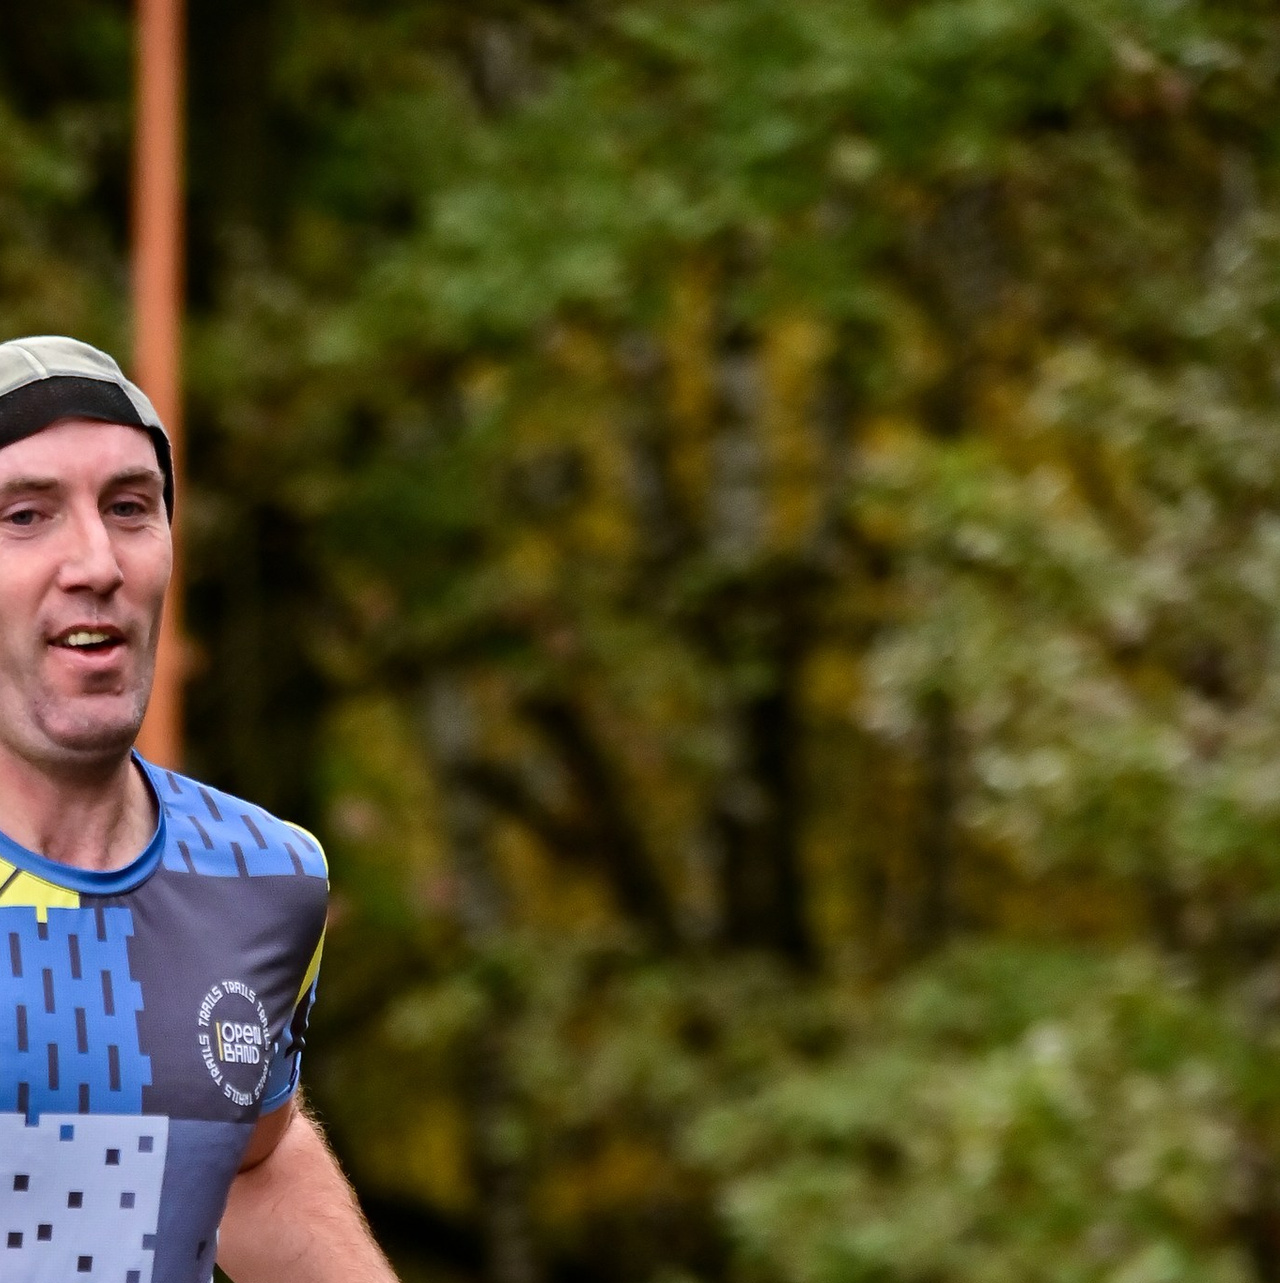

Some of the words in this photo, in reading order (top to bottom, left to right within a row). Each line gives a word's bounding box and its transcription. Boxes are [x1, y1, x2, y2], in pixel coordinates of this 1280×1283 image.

[222, 981, 256, 1004] TRAILS
[198, 985, 223, 1027] TRAILS
[198, 1034, 223, 1086] TRAILS
[223, 1043, 260, 1064] BAND
[223, 1082, 253, 1106] TRAILS
